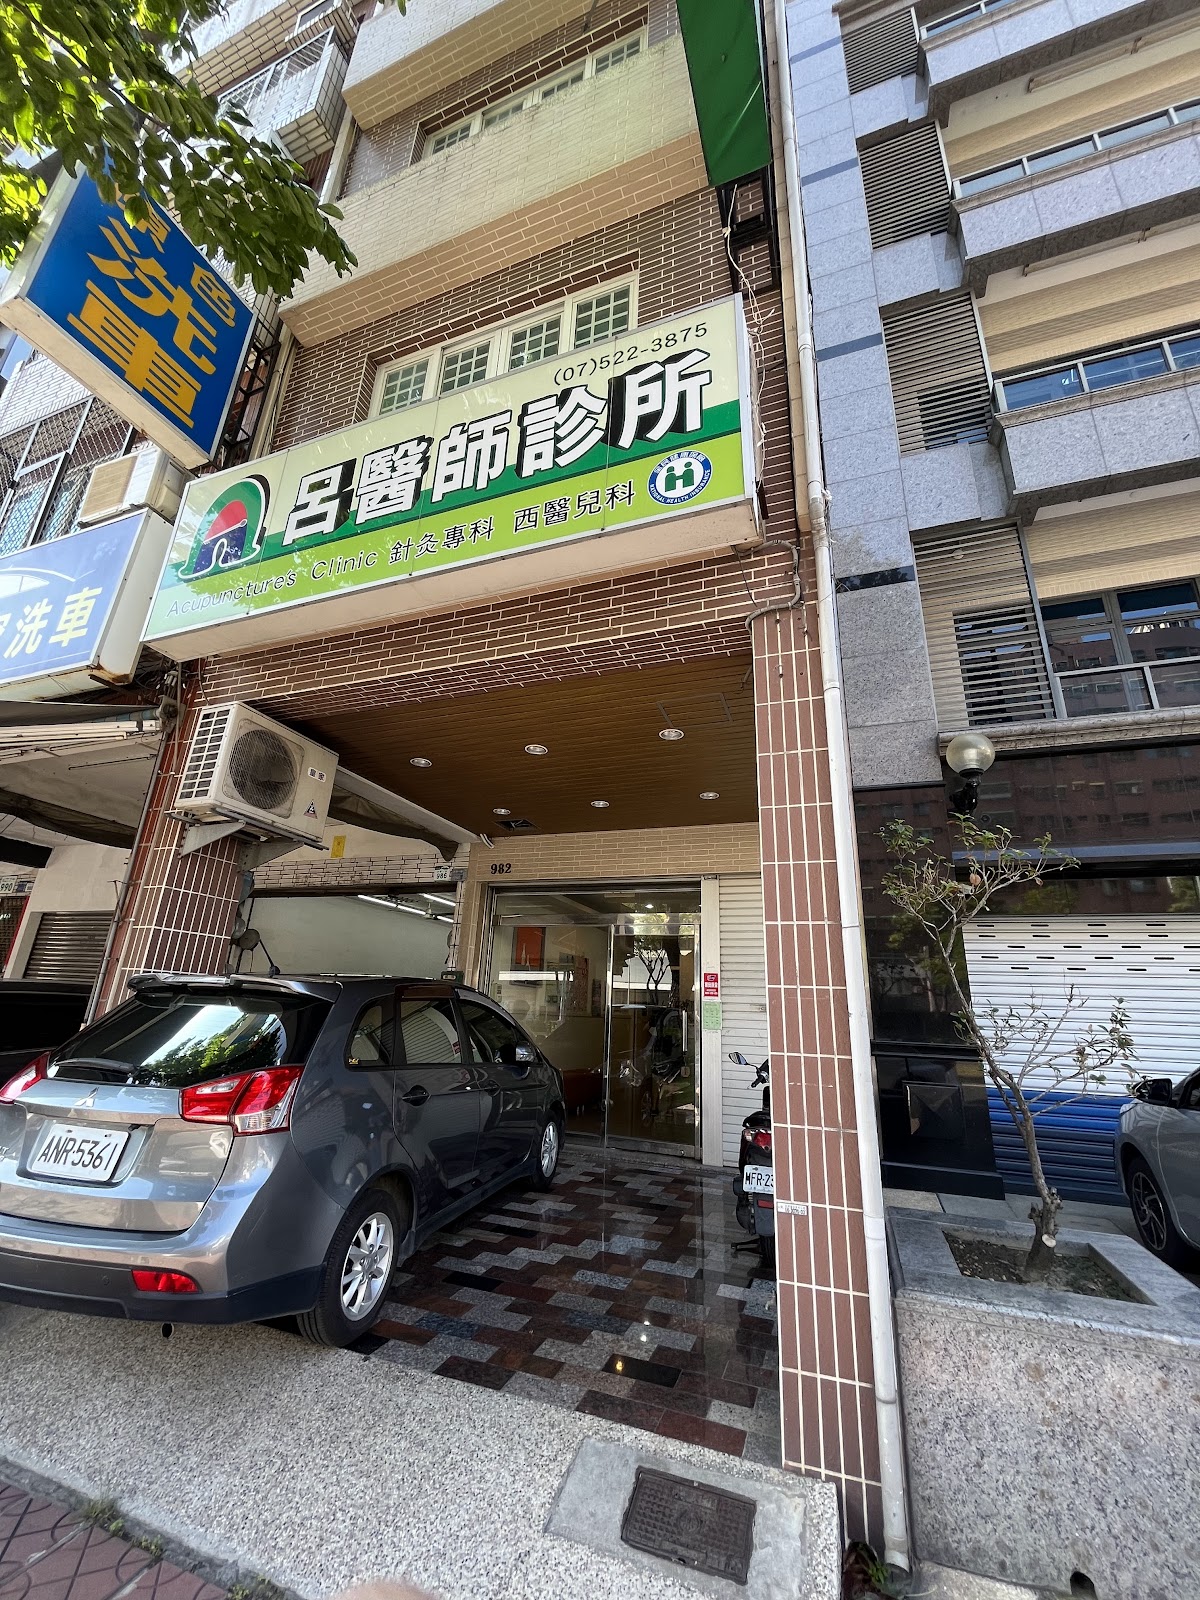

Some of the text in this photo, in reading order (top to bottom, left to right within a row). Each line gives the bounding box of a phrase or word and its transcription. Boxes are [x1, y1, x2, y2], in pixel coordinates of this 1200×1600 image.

[67, 216, 218, 429] 洗車
[554, 322, 708, 386] (07)522-3875
[282, 348, 712, 546] 呂醫師診所
[311, 550, 379, 581] Clinic
[388, 515, 495, 565] 針灸專科
[513, 479, 636, 534] 西醫兒科
[0, 586, 103, 660] 洗車
[490, 863, 512, 874] 982
